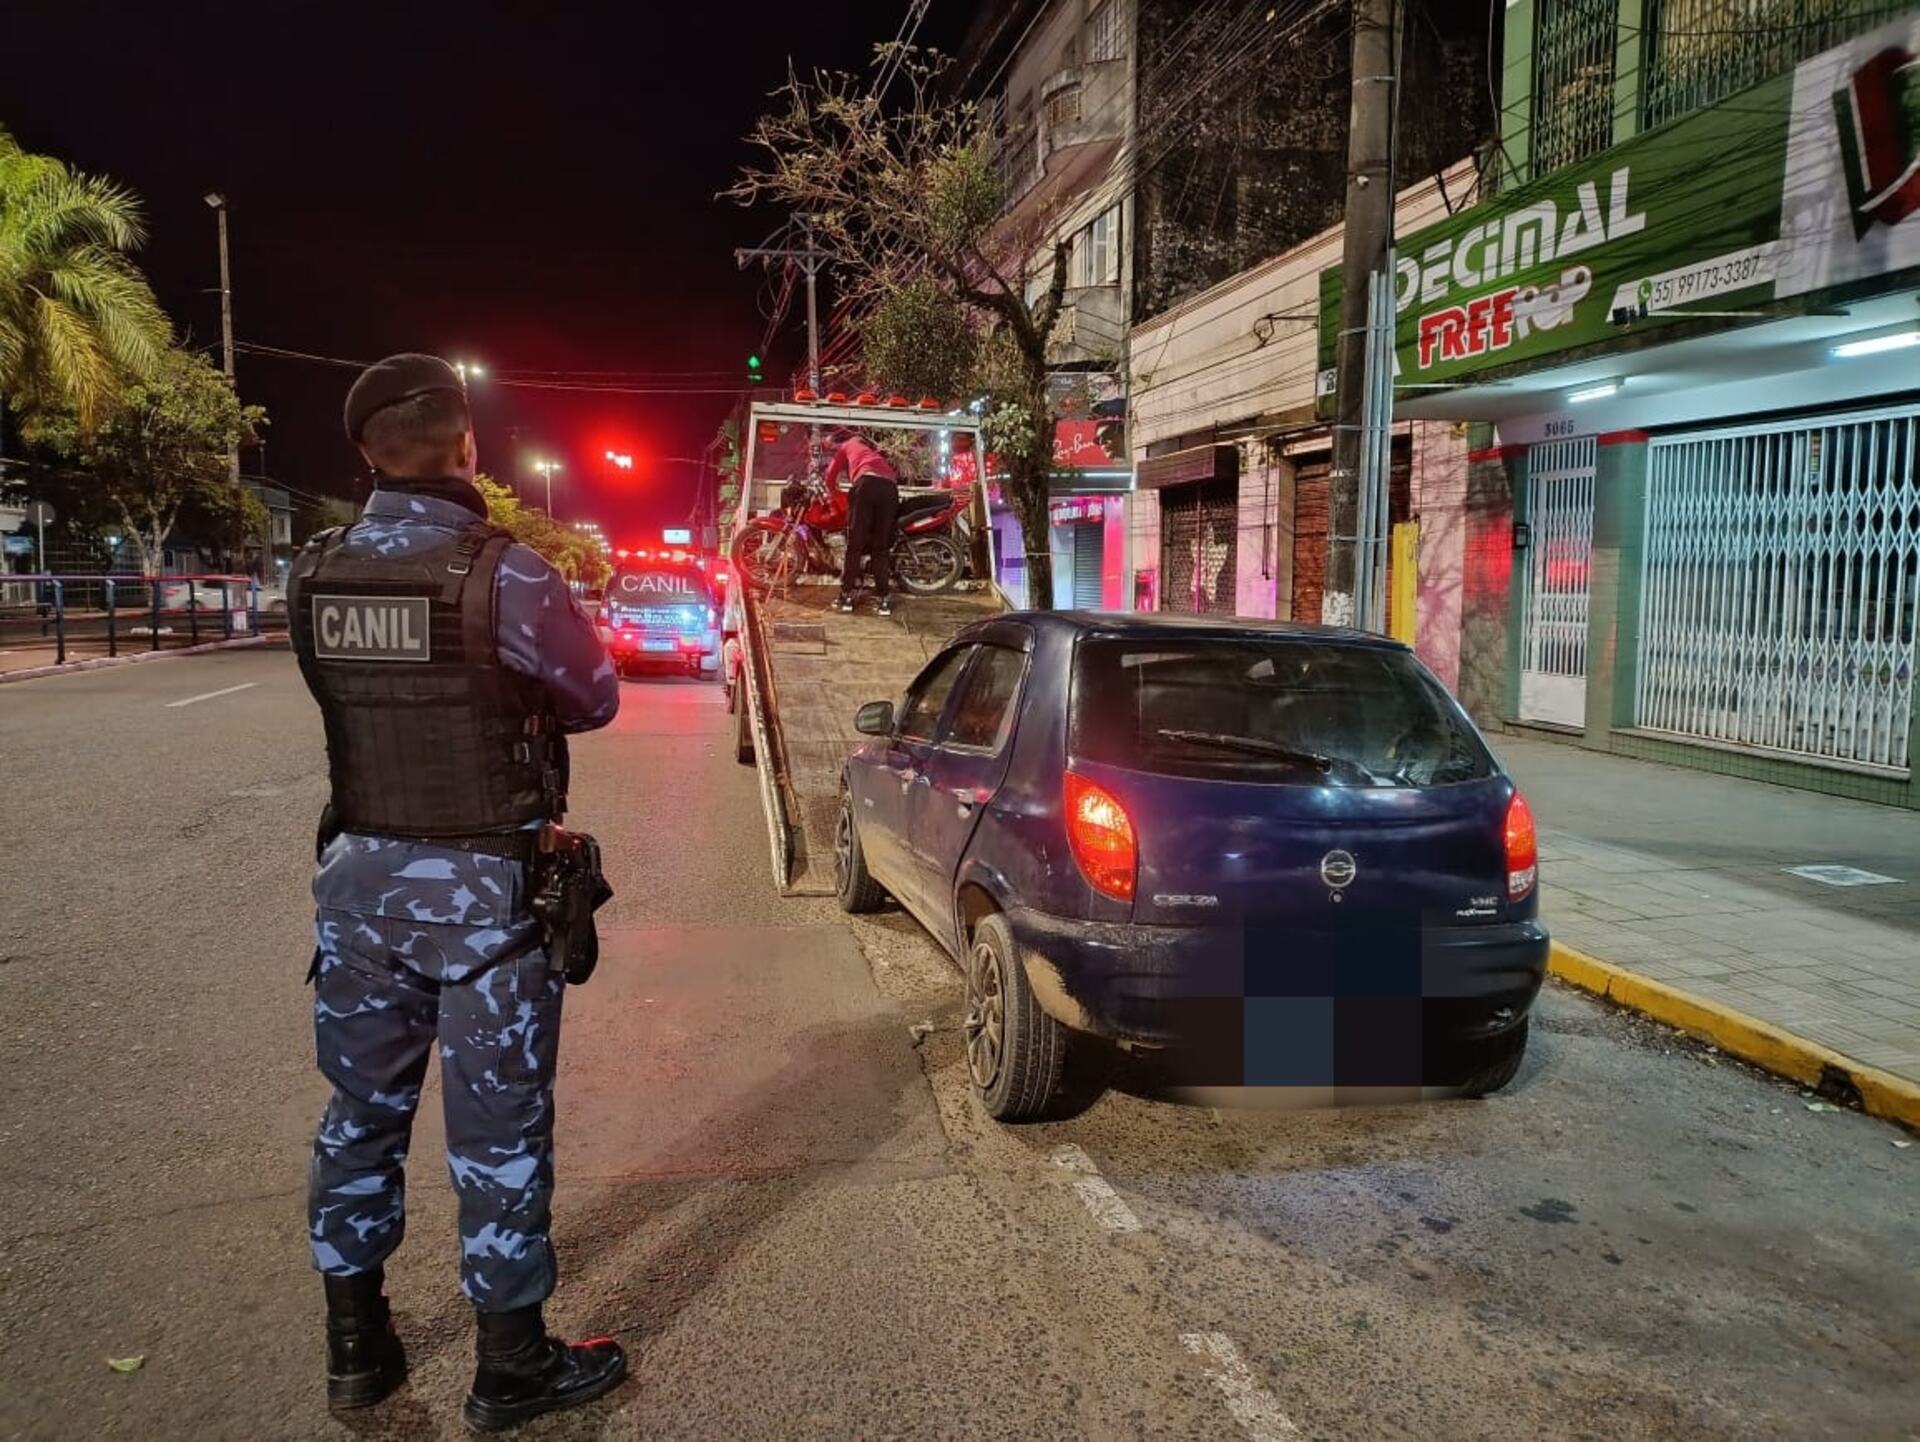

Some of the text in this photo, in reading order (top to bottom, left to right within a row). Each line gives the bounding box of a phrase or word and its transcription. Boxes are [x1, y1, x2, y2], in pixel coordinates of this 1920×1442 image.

[1678, 256, 1760, 297] 99173-3387
[621, 575, 696, 594] CANIL
[321, 605, 421, 650] CANIL
